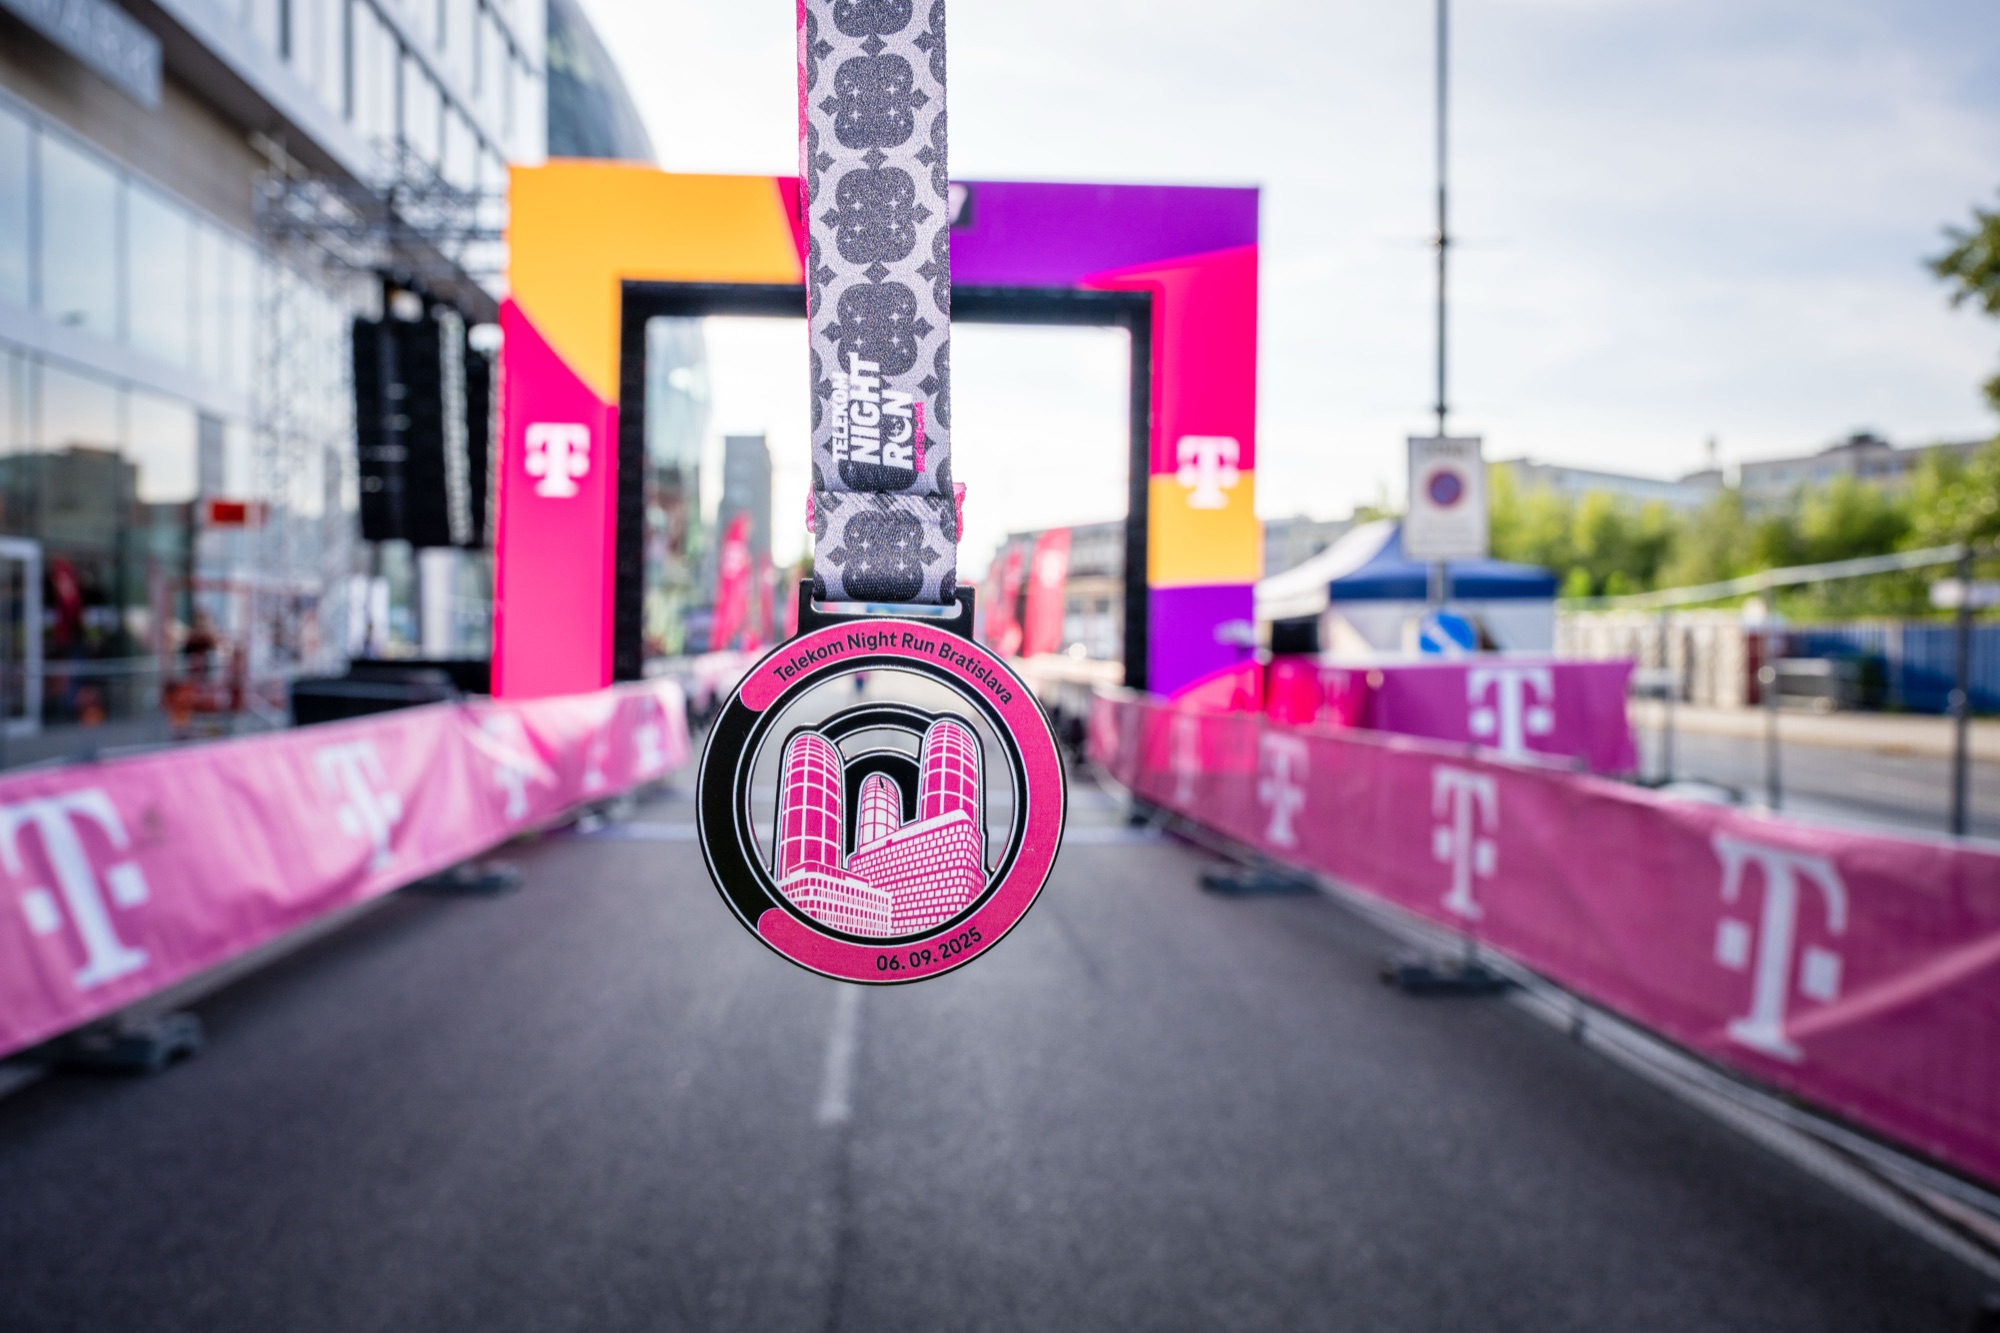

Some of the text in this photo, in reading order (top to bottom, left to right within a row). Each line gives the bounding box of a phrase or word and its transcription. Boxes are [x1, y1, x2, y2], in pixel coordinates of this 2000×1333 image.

[832, 371, 849, 462] TELEKOM
[847, 352, 881, 465] NIGHT
[773, 631, 1013, 705] Telekom Night Run Bratislava
